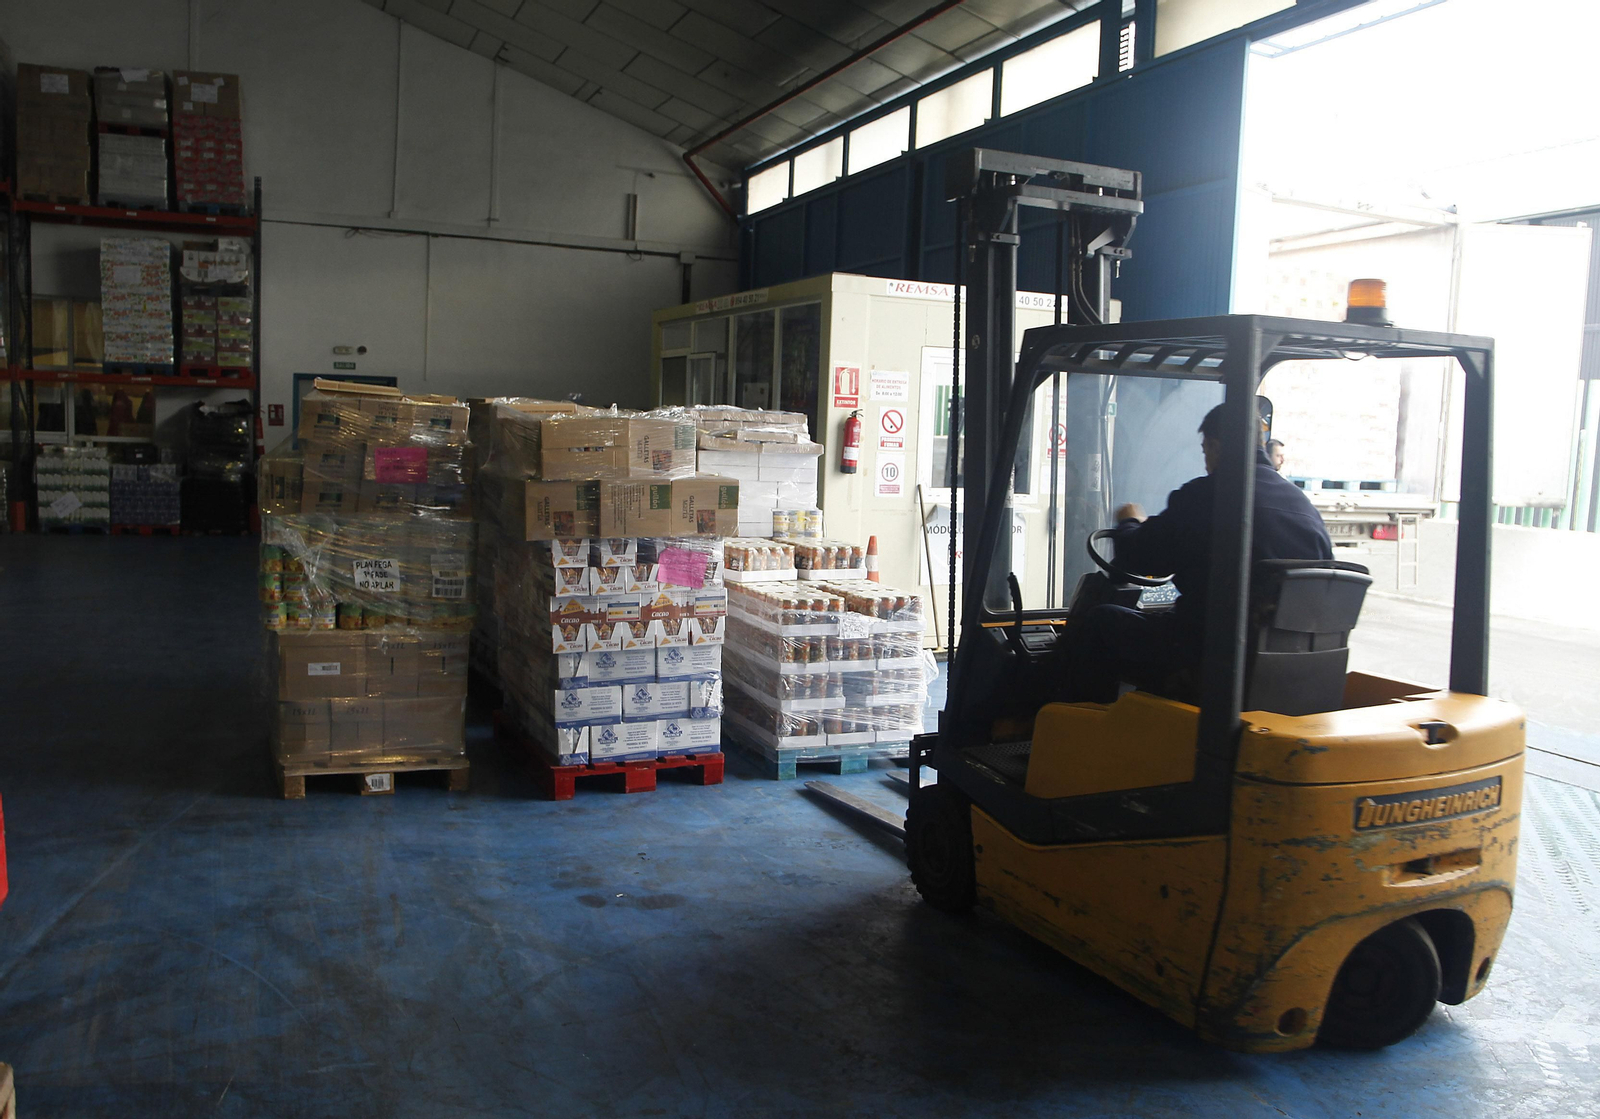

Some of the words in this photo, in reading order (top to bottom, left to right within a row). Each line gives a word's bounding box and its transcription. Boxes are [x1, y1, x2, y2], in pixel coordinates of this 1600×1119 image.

[895, 282, 949, 297] REMSA
[1018, 296, 1030, 305] 40
[1033, 297, 1044, 307] 50
[1046, 298, 1056, 308] 2
[884, 466, 896, 478] 10
[651, 486, 660, 509] gullón
[720, 487, 729, 508] gullón
[355, 561, 373, 570] PLAN
[374, 560, 393, 569] FEGA
[370, 571, 388, 579] FASE
[359, 580, 370, 588] NO
[1357, 784, 1500, 828] JUNGHEINRICH
